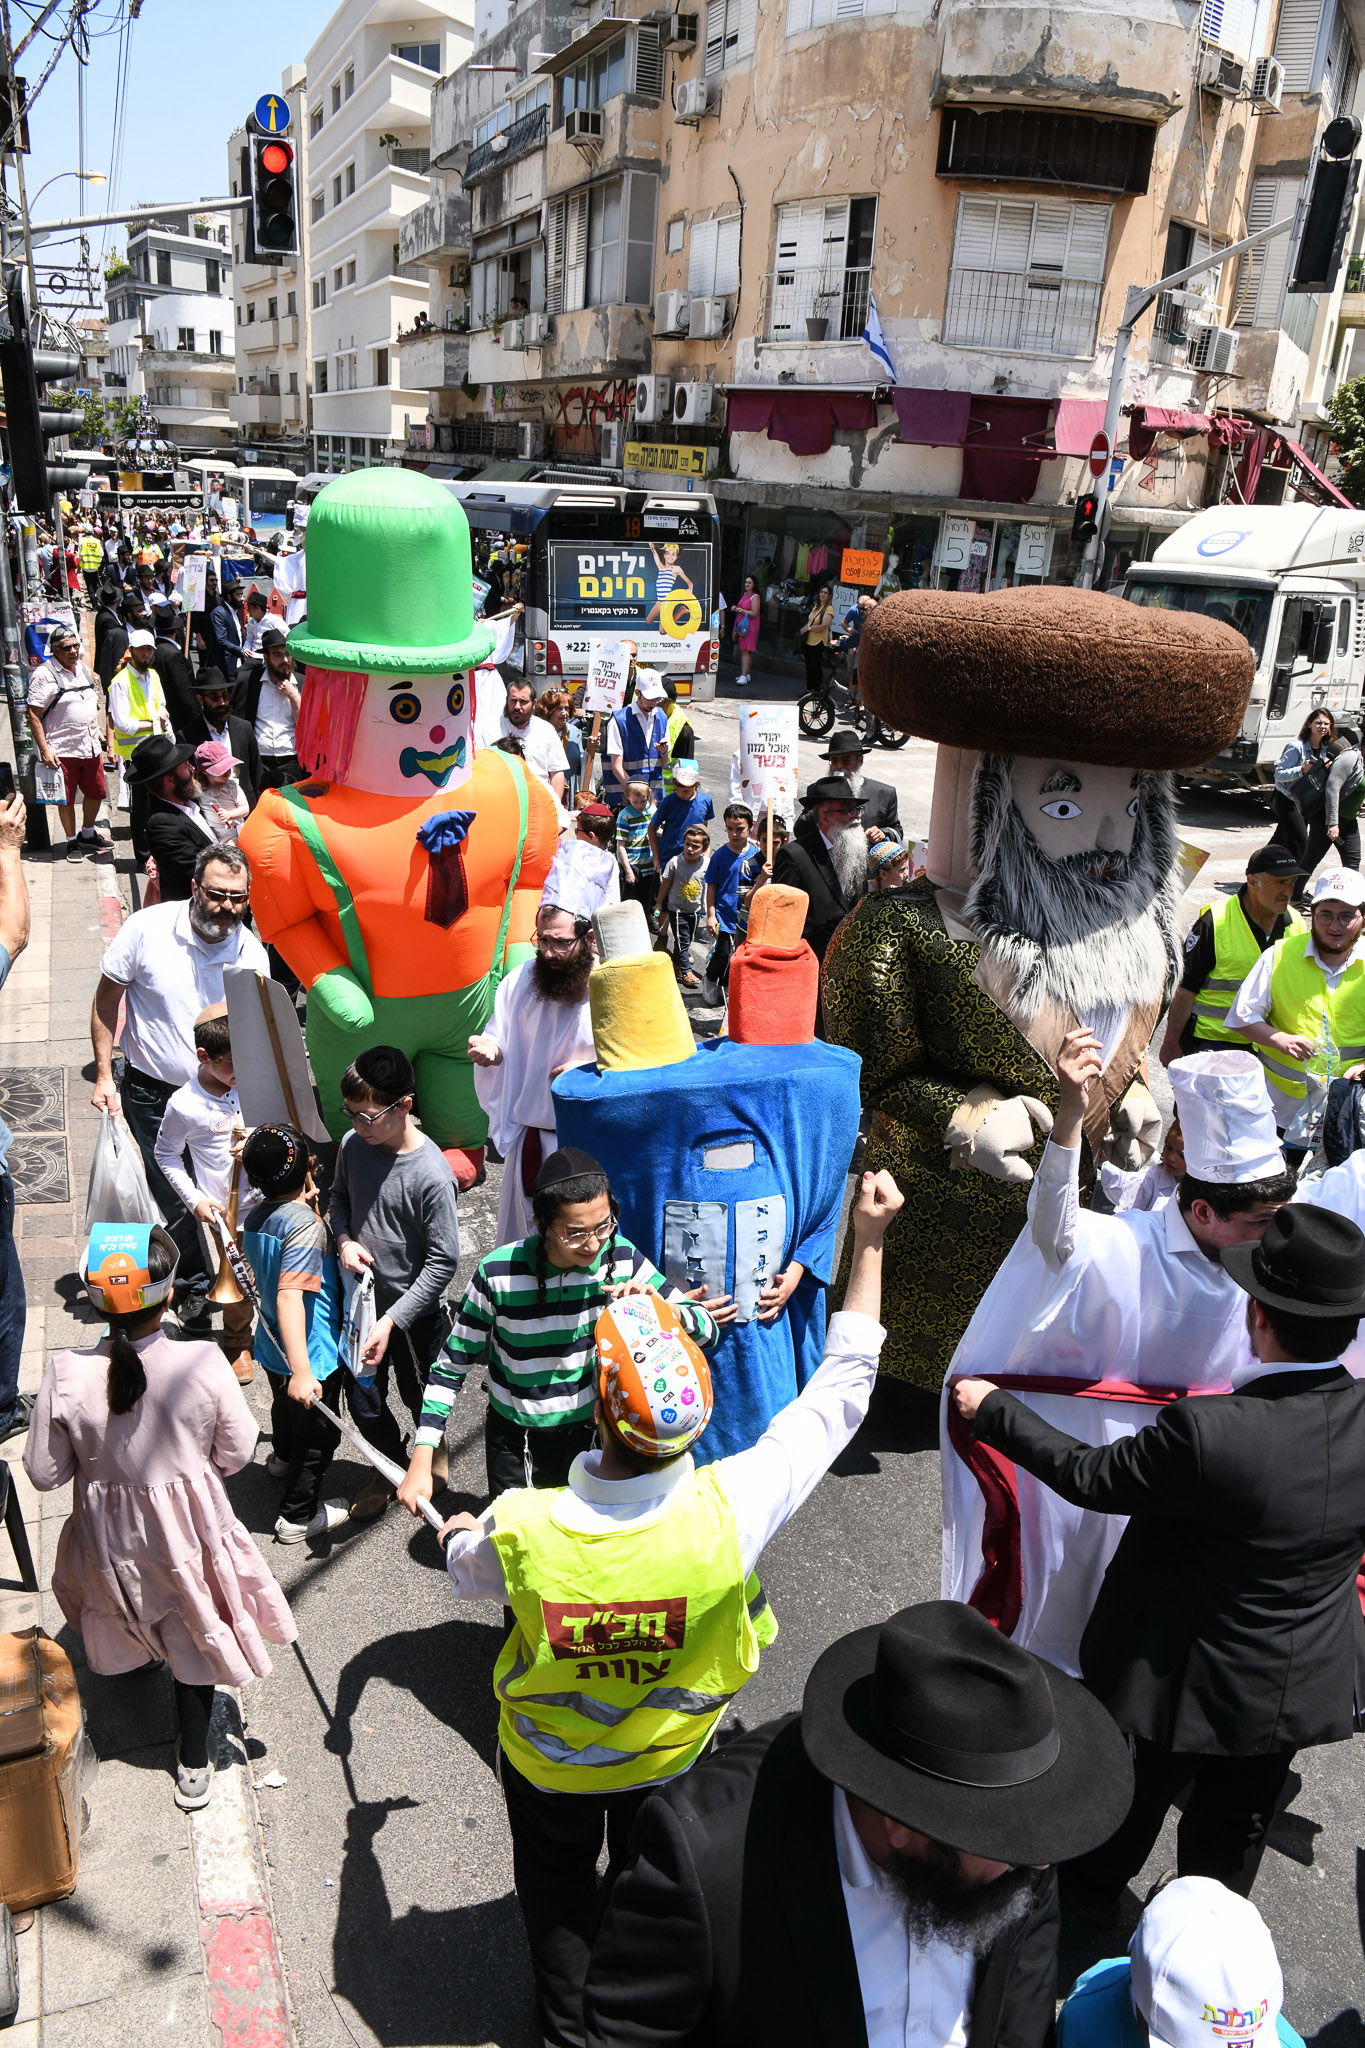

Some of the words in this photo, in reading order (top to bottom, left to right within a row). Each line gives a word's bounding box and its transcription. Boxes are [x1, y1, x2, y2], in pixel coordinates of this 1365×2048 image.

[947, 537, 965, 563] 5
[1027, 545, 1044, 569] 5
[578, 551, 645, 575] ילדים
[578, 576, 645, 598] חינם
[612, 607, 629, 615] הקיץ
[629, 606, 638, 614] כל
[598, 660, 615, 669] יהודי
[603, 667, 621, 680] אוכל
[758, 732, 780, 742] יהודי
[747, 743, 765, 754] מזון
[768, 742, 790, 753] אוכל
[597, 1641, 620, 1650] לכל
[623, 1639, 647, 1648] הלב
[650, 1639, 666, 1647] כל
[569, 1644, 595, 1653] אחד
[576, 1658, 671, 1686] צוות
